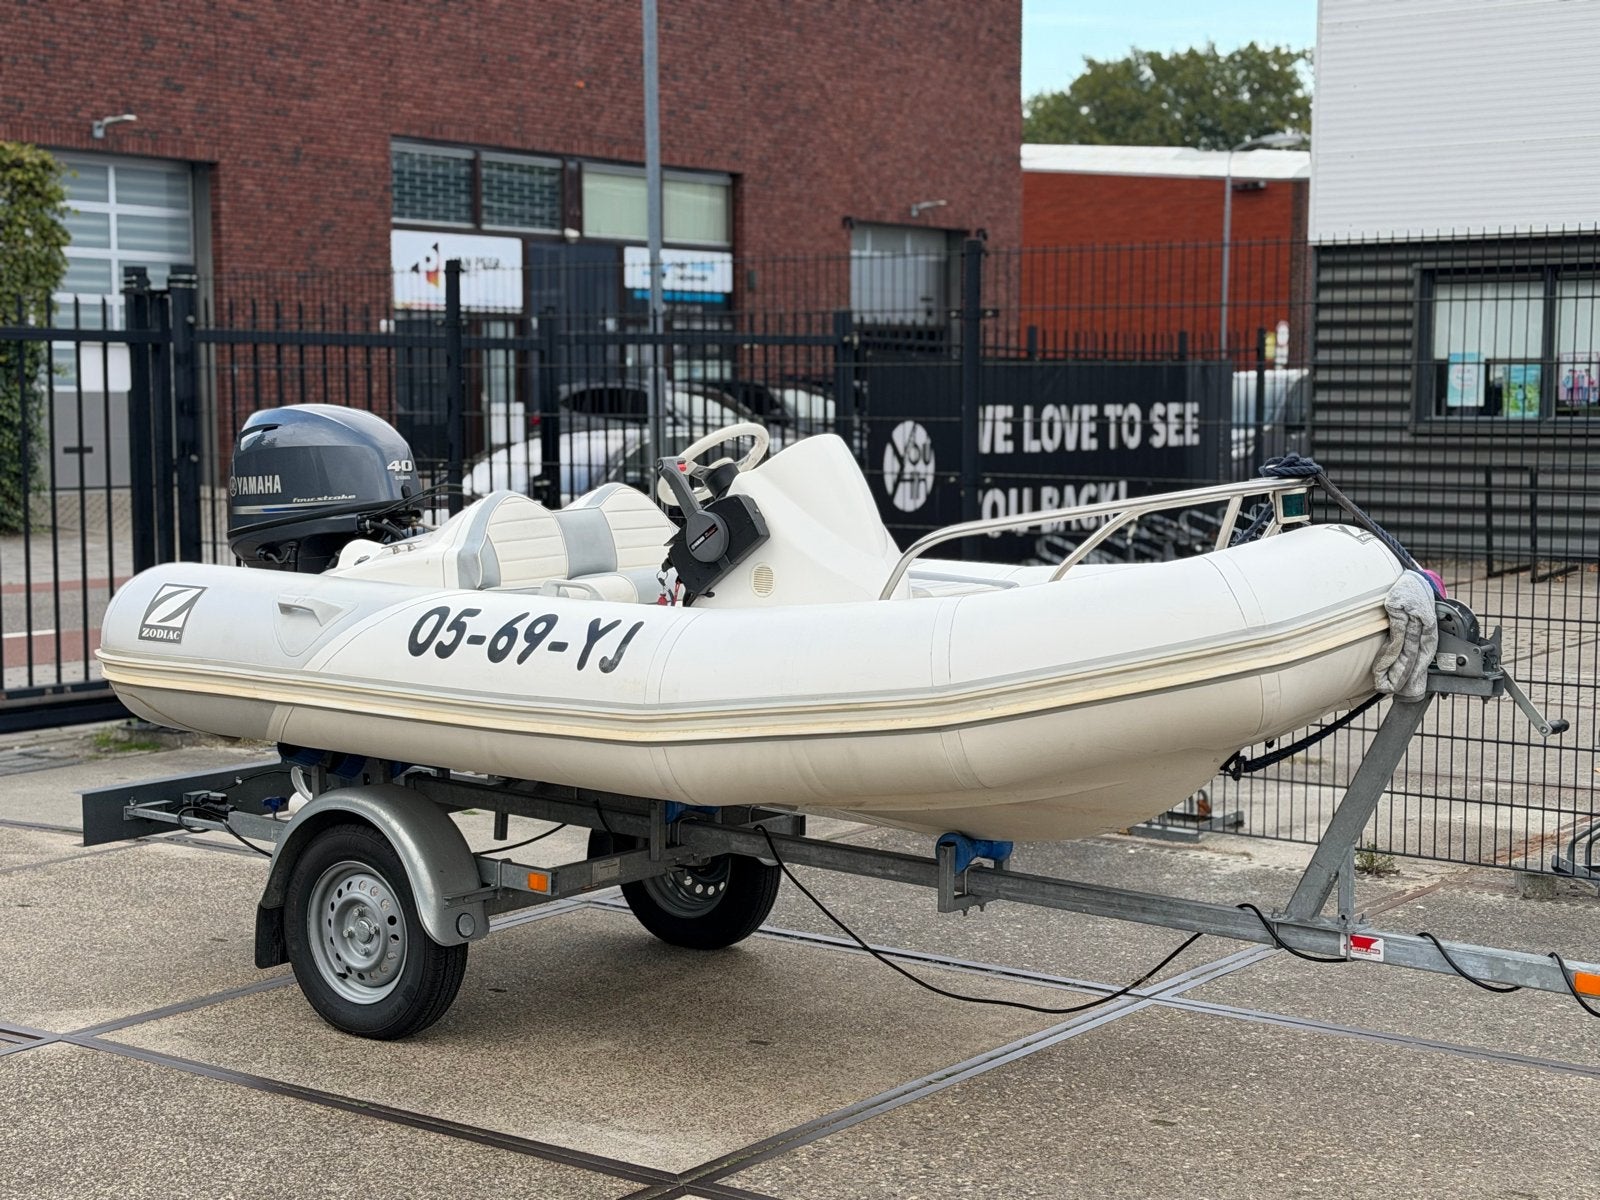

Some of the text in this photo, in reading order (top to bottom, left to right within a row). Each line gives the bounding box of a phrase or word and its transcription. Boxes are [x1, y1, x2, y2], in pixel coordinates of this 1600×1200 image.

[1023, 403, 1098, 453] LOVE
[1104, 402, 1142, 450] TO
[1150, 401, 1200, 448] SEE
[386, 460, 413, 472] 40
[236, 474, 282, 496] YAMAHA
[141, 627, 181, 640] ZODIAC
[407, 605, 645, 674] 05-69-YJ
